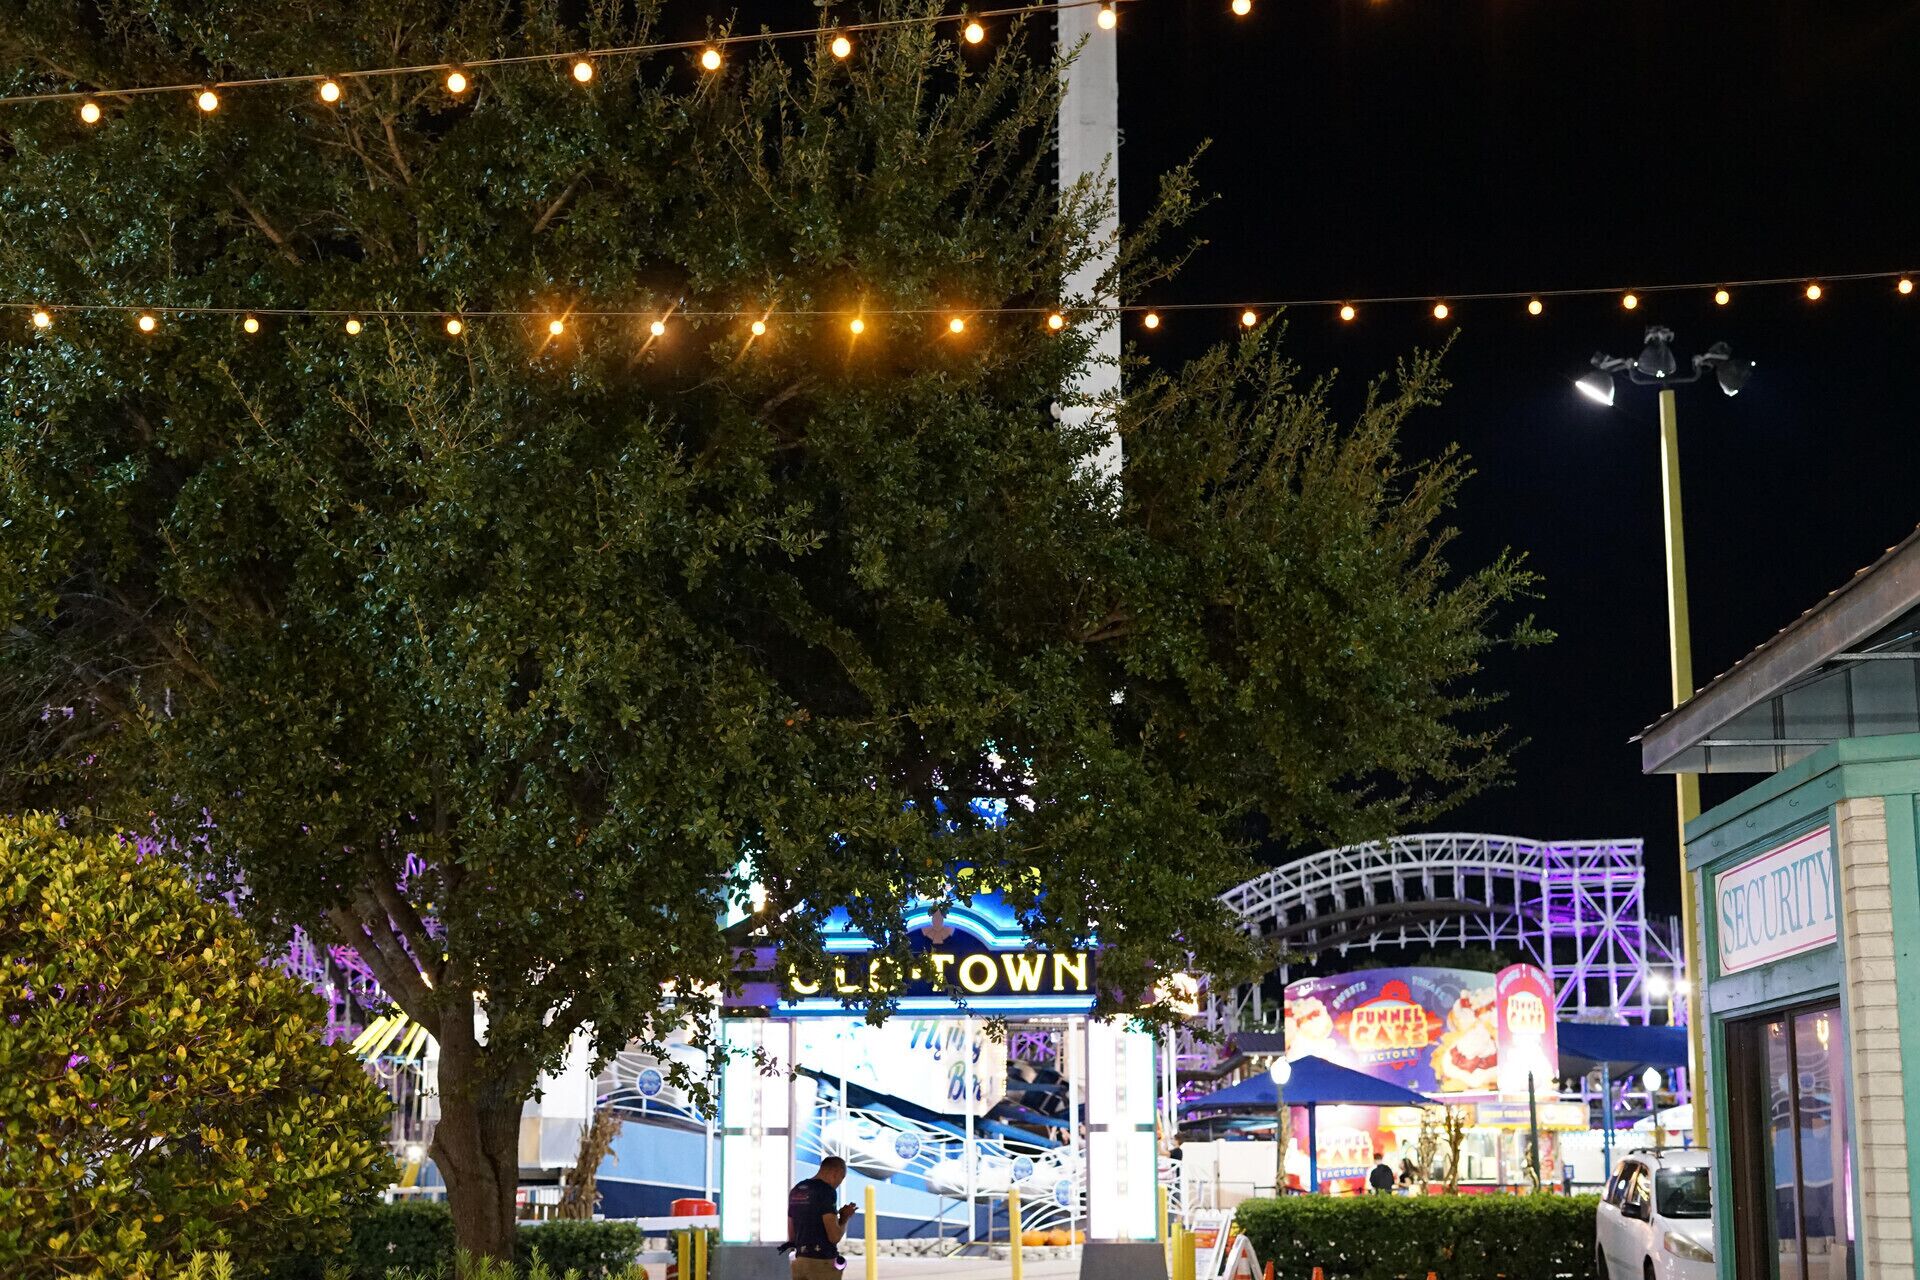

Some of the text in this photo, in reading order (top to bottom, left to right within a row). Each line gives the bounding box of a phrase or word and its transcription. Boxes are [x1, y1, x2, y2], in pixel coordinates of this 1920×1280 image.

[1722, 847, 1833, 955] SECURITY
[929, 953, 1088, 993] TOWN
[1356, 1007, 1422, 1024] FUNNEL
[1354, 1023, 1425, 1046] CAKE
